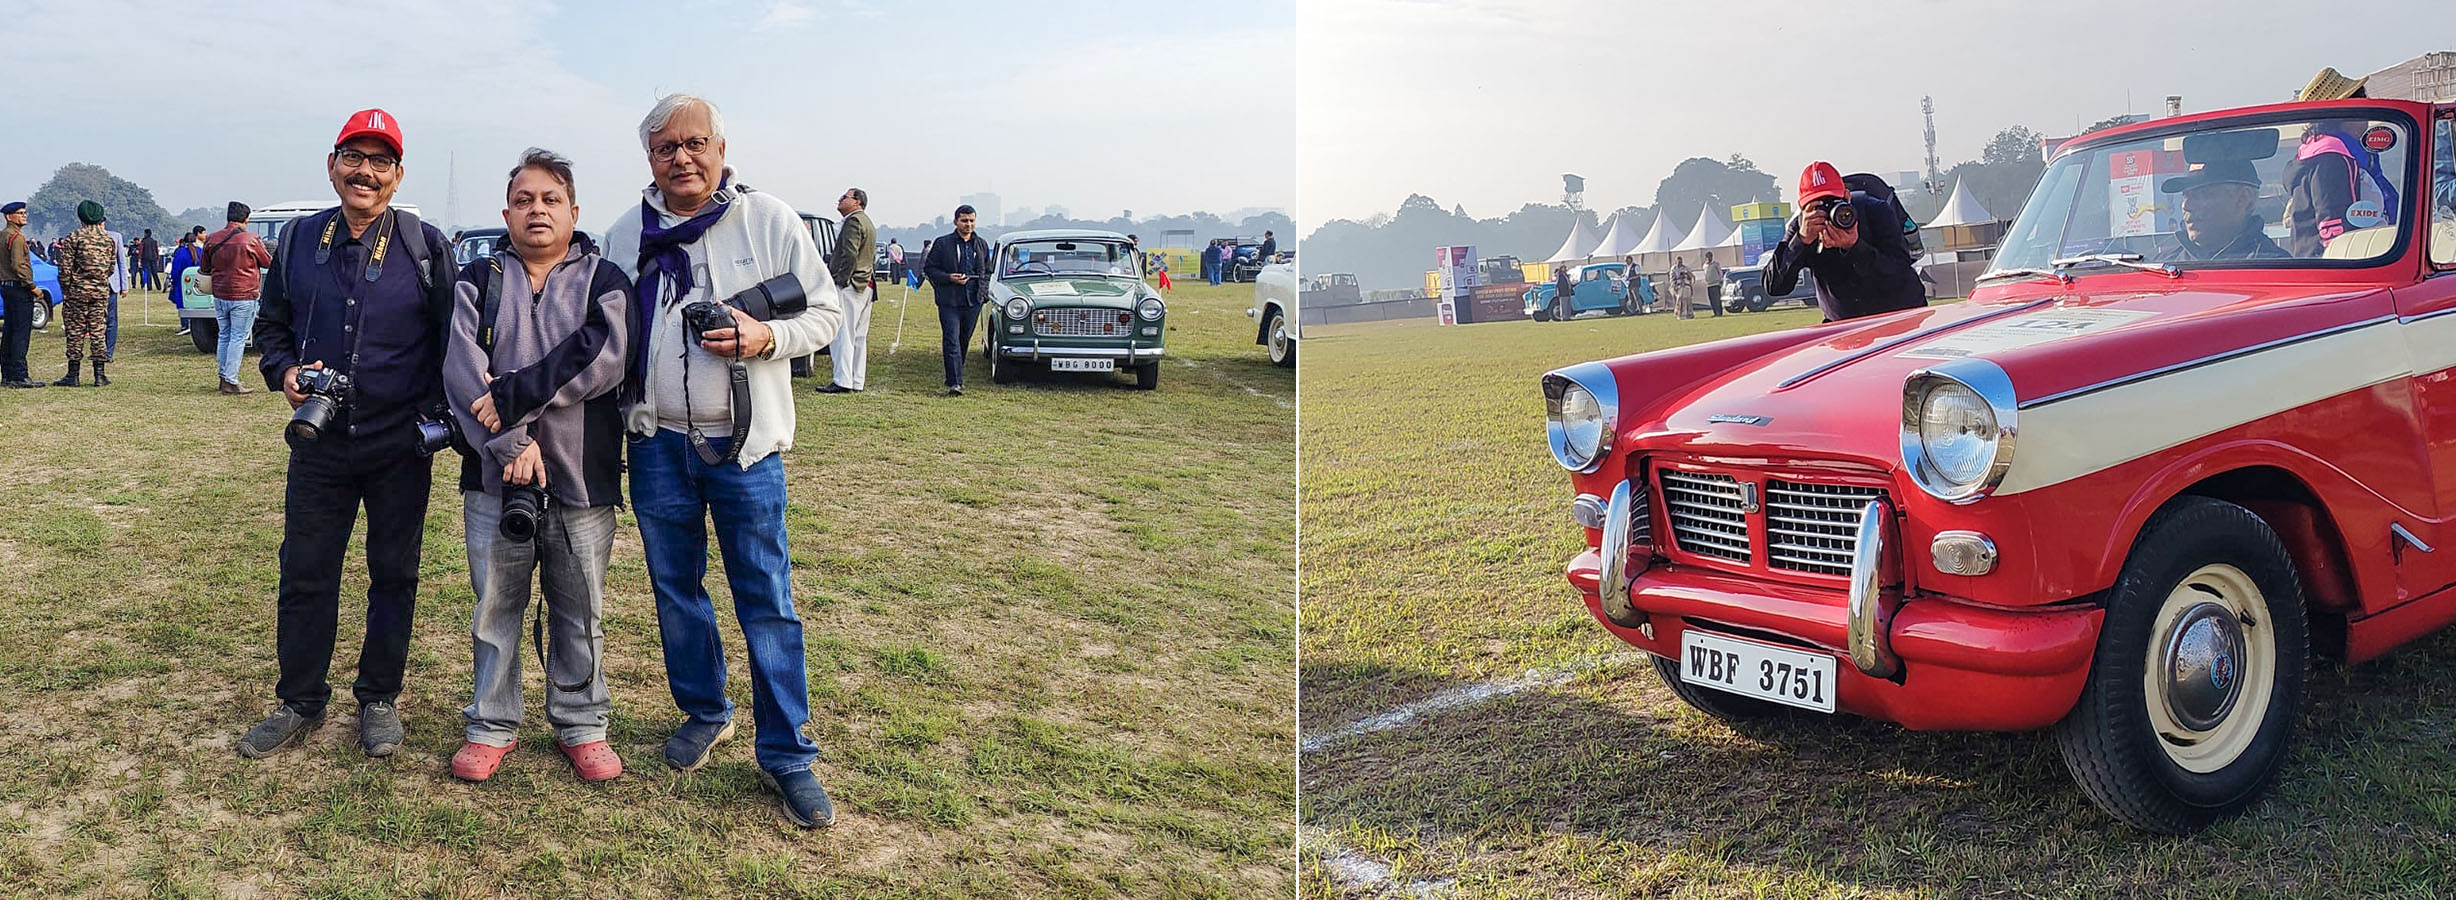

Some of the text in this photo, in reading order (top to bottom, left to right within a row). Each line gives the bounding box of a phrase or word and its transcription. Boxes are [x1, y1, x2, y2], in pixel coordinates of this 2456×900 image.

[2350, 210, 2378, 218] EXIDE
[323, 221, 335, 244] Nikon
[373, 236, 387, 260] Nikon
[1058, 361, 1112, 369] WBG 8000
[1689, 645, 1824, 703] WBF 3751
